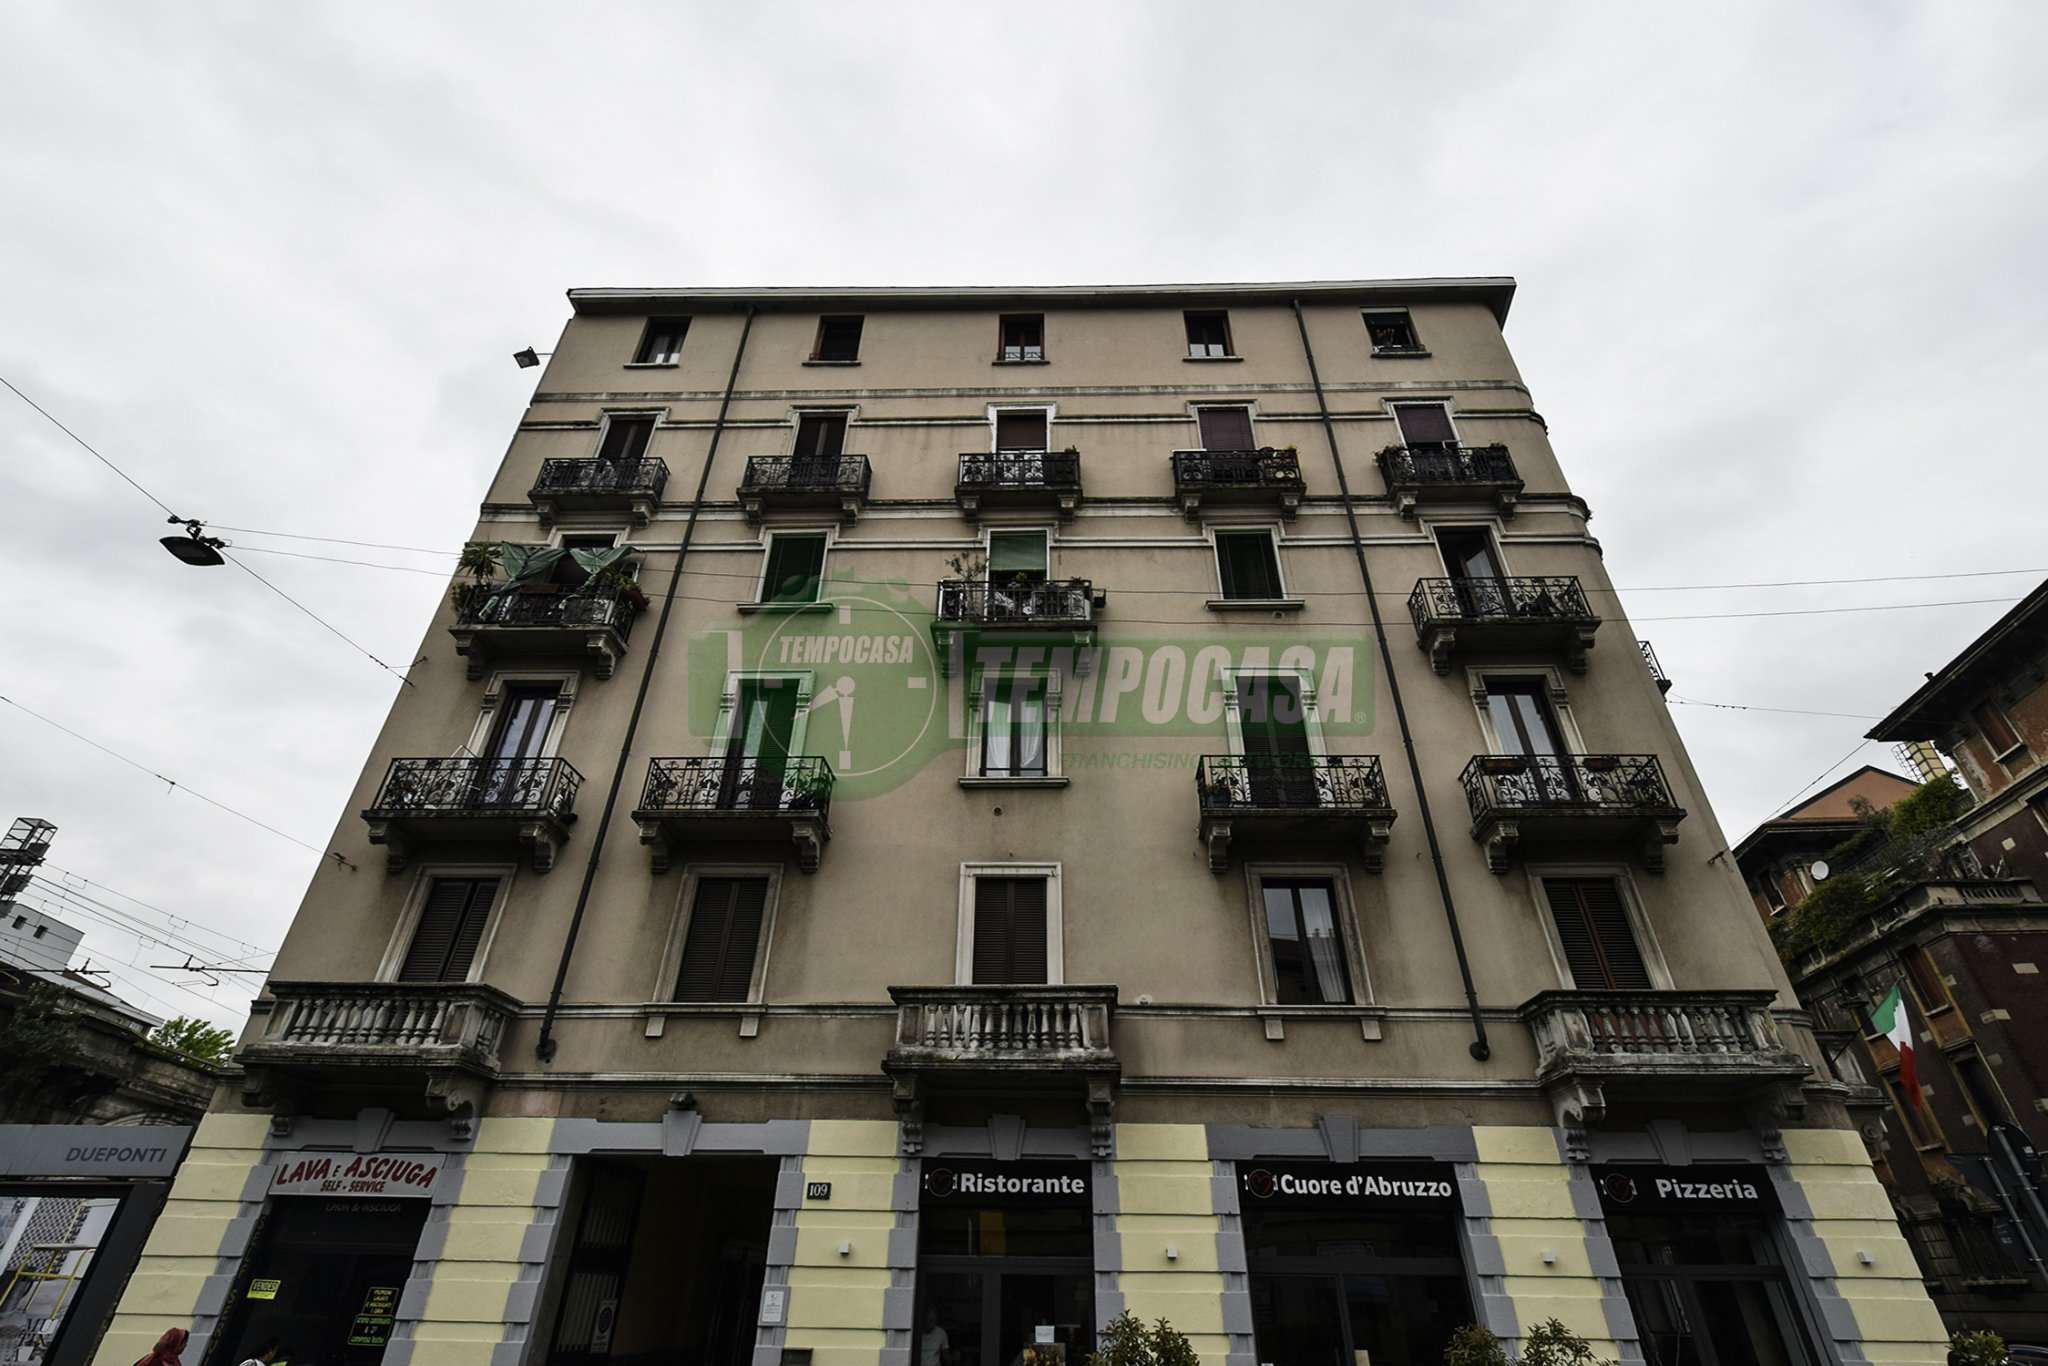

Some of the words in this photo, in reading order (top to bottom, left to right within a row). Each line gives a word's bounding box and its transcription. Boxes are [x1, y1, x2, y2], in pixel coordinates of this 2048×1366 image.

[65, 1146, 167, 1162] DUEPONTI
[276, 1158, 332, 1185] LAVA
[333, 1164, 341, 1178] E
[344, 1156, 438, 1188] ASCIUGA
[320, 1180, 341, 1192] SELF
[348, 1180, 386, 1193] SERVICE
[808, 1183, 828, 1197] 109
[960, 1173, 1085, 1194] Ristorante
[1280, 1174, 1342, 1195] Cuore
[1346, 1175, 1452, 1197] d'Abruzzo
[1655, 1178, 1758, 1199] Pizzeria
